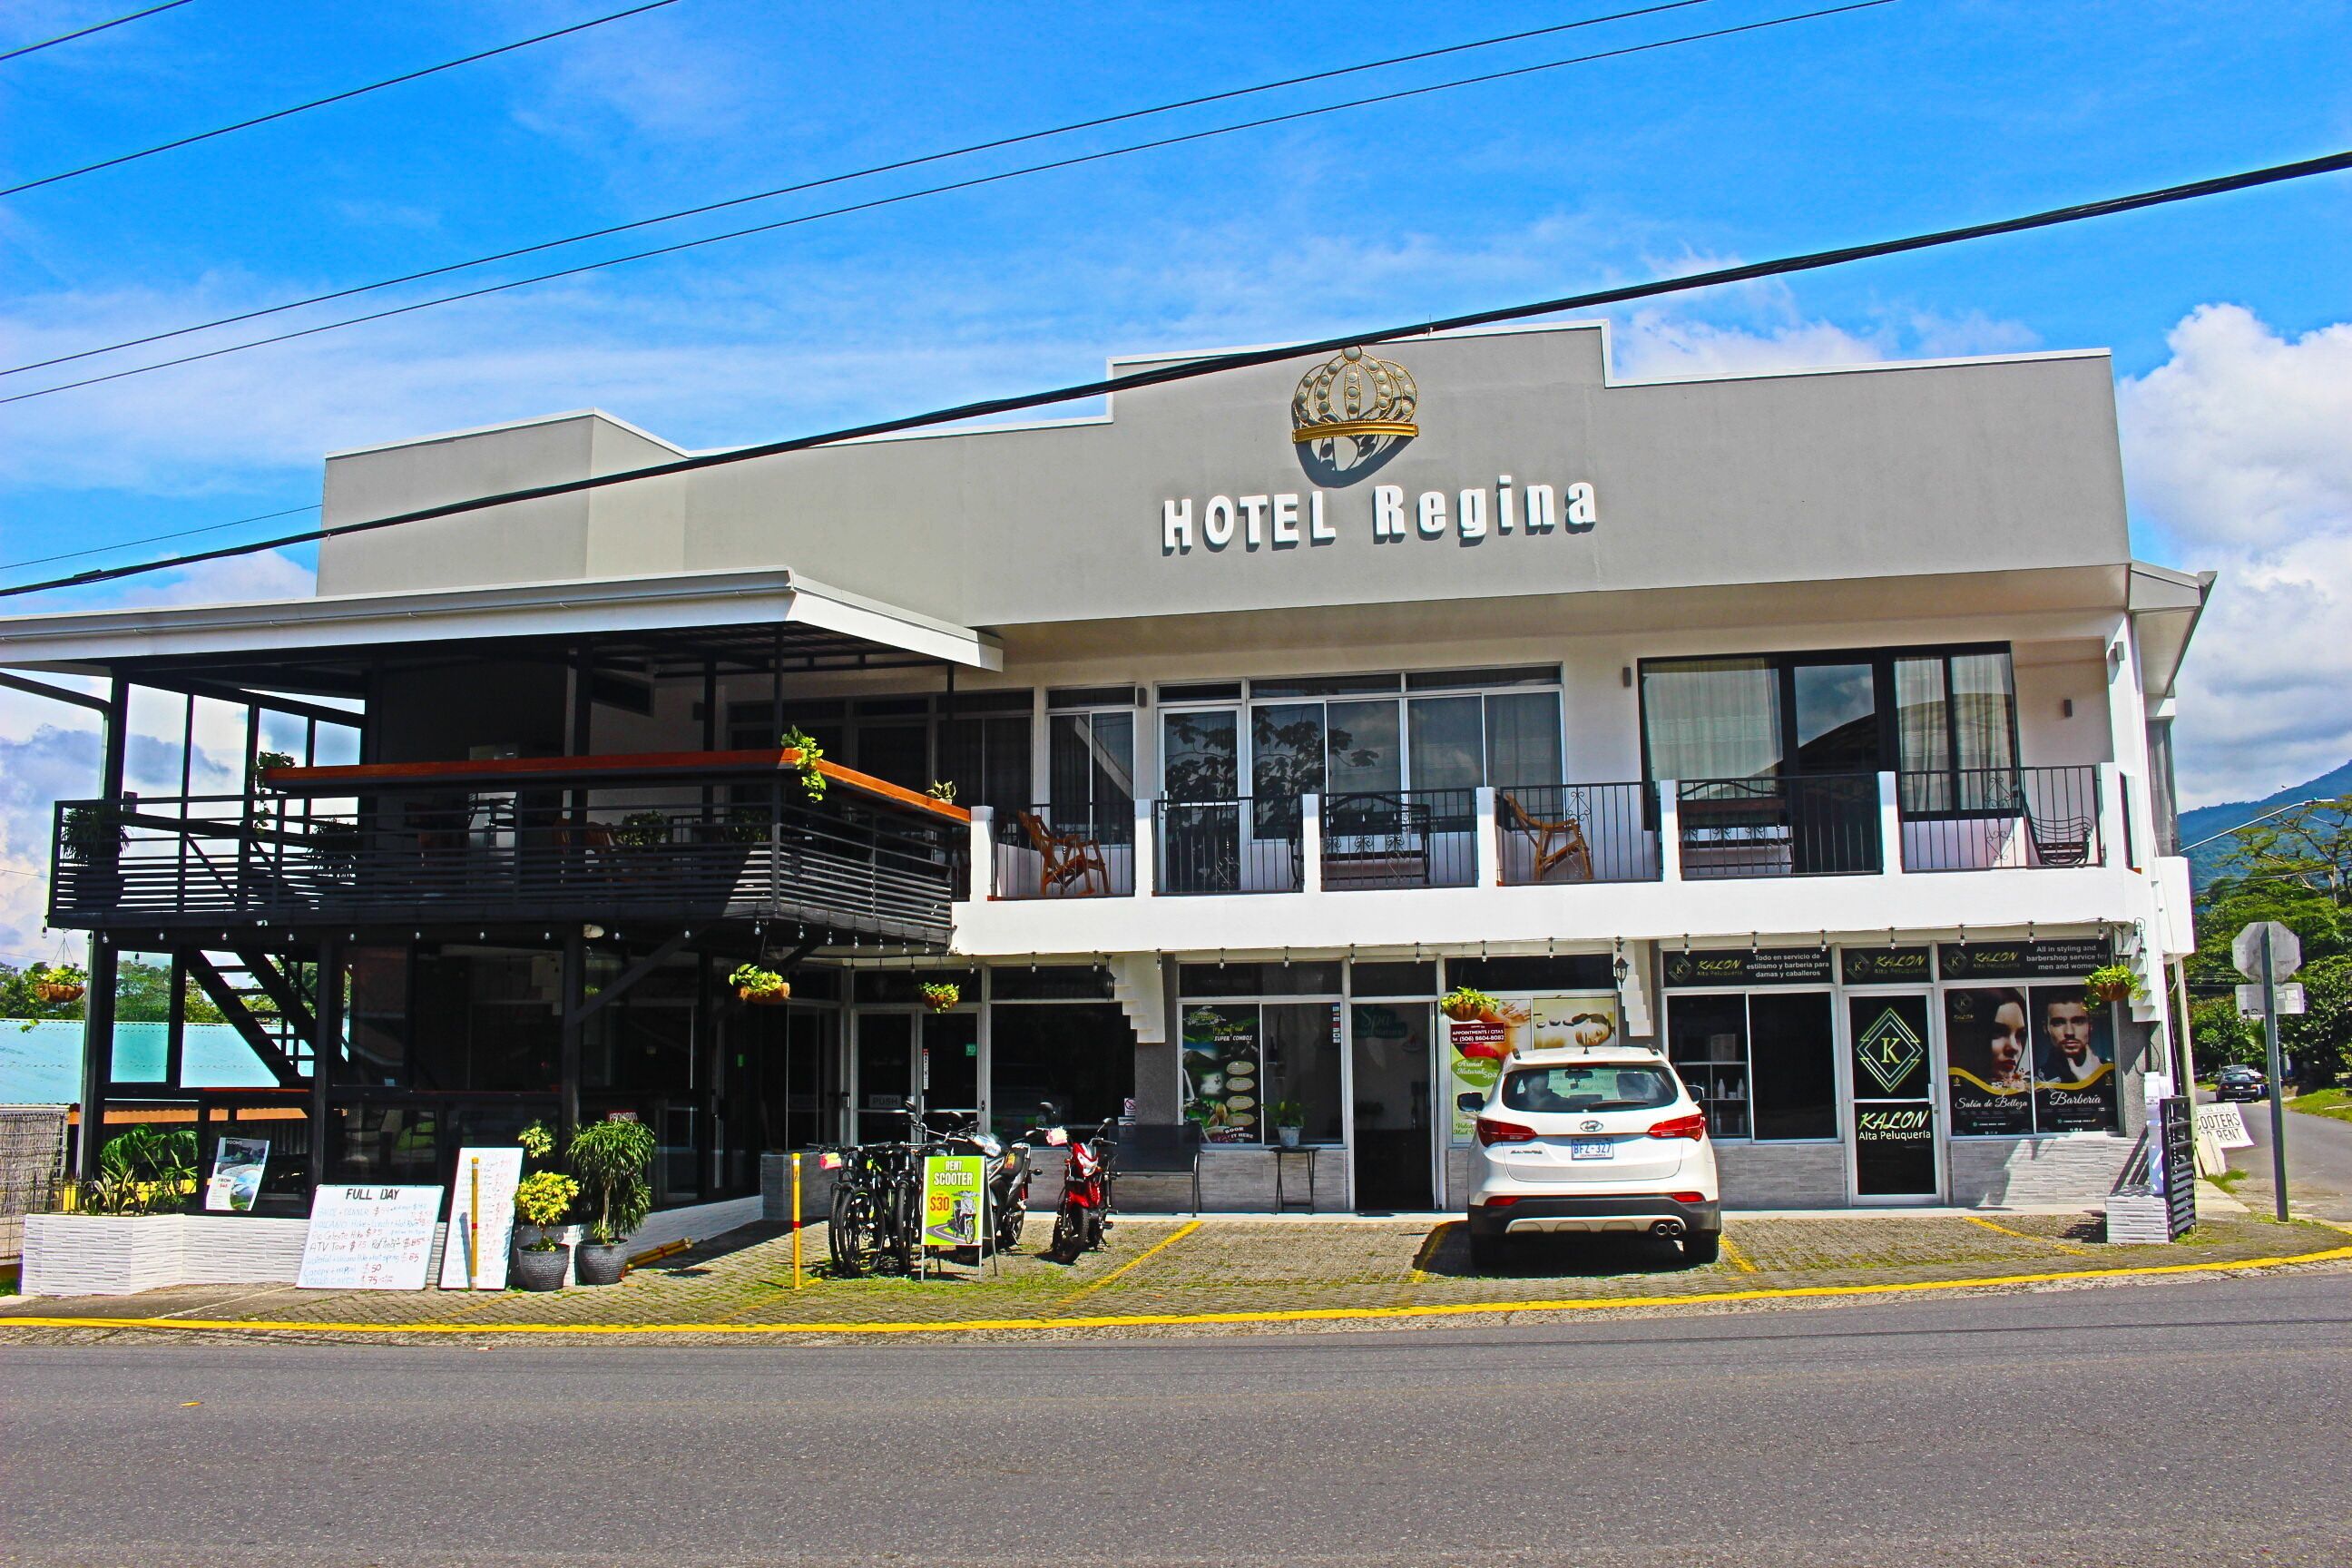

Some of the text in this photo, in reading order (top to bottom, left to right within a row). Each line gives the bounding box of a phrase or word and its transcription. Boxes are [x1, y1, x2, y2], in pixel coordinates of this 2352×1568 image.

[1163, 475, 1596, 548] HOTEL Regina
[2056, 945, 2082, 953] styling
[1874, 955, 1927, 967] KALON
[1951, 957, 1958, 966] K
[1973, 952, 2019, 963] KALON
[1676, 965, 1683, 974] K
[1697, 958, 1742, 970] KALON
[1854, 962, 1862, 971] K
[1880, 1037, 1901, 1063] K
[1483, 1071, 1497, 1079] Spa
[872, 1097, 898, 1105] PUSH
[1955, 1095, 2028, 1110] Salón de Belleza
[2049, 1091, 2102, 1106] Barbería
[1858, 1110, 1929, 1130] KALON
[1858, 1131, 1877, 1141] Alta
[2216, 1129, 2242, 1141] RENT
[1573, 1143, 1612, 1154] BFZ-327
[945, 1161, 963, 1171] RENT
[933, 1171, 974, 1186] SCOOTER
[346, 1188, 401, 1200] FULL DAY
[929, 1196, 950, 1211] $30
[309, 1241, 329, 1252] ATV
[331, 1241, 347, 1251] Tour
